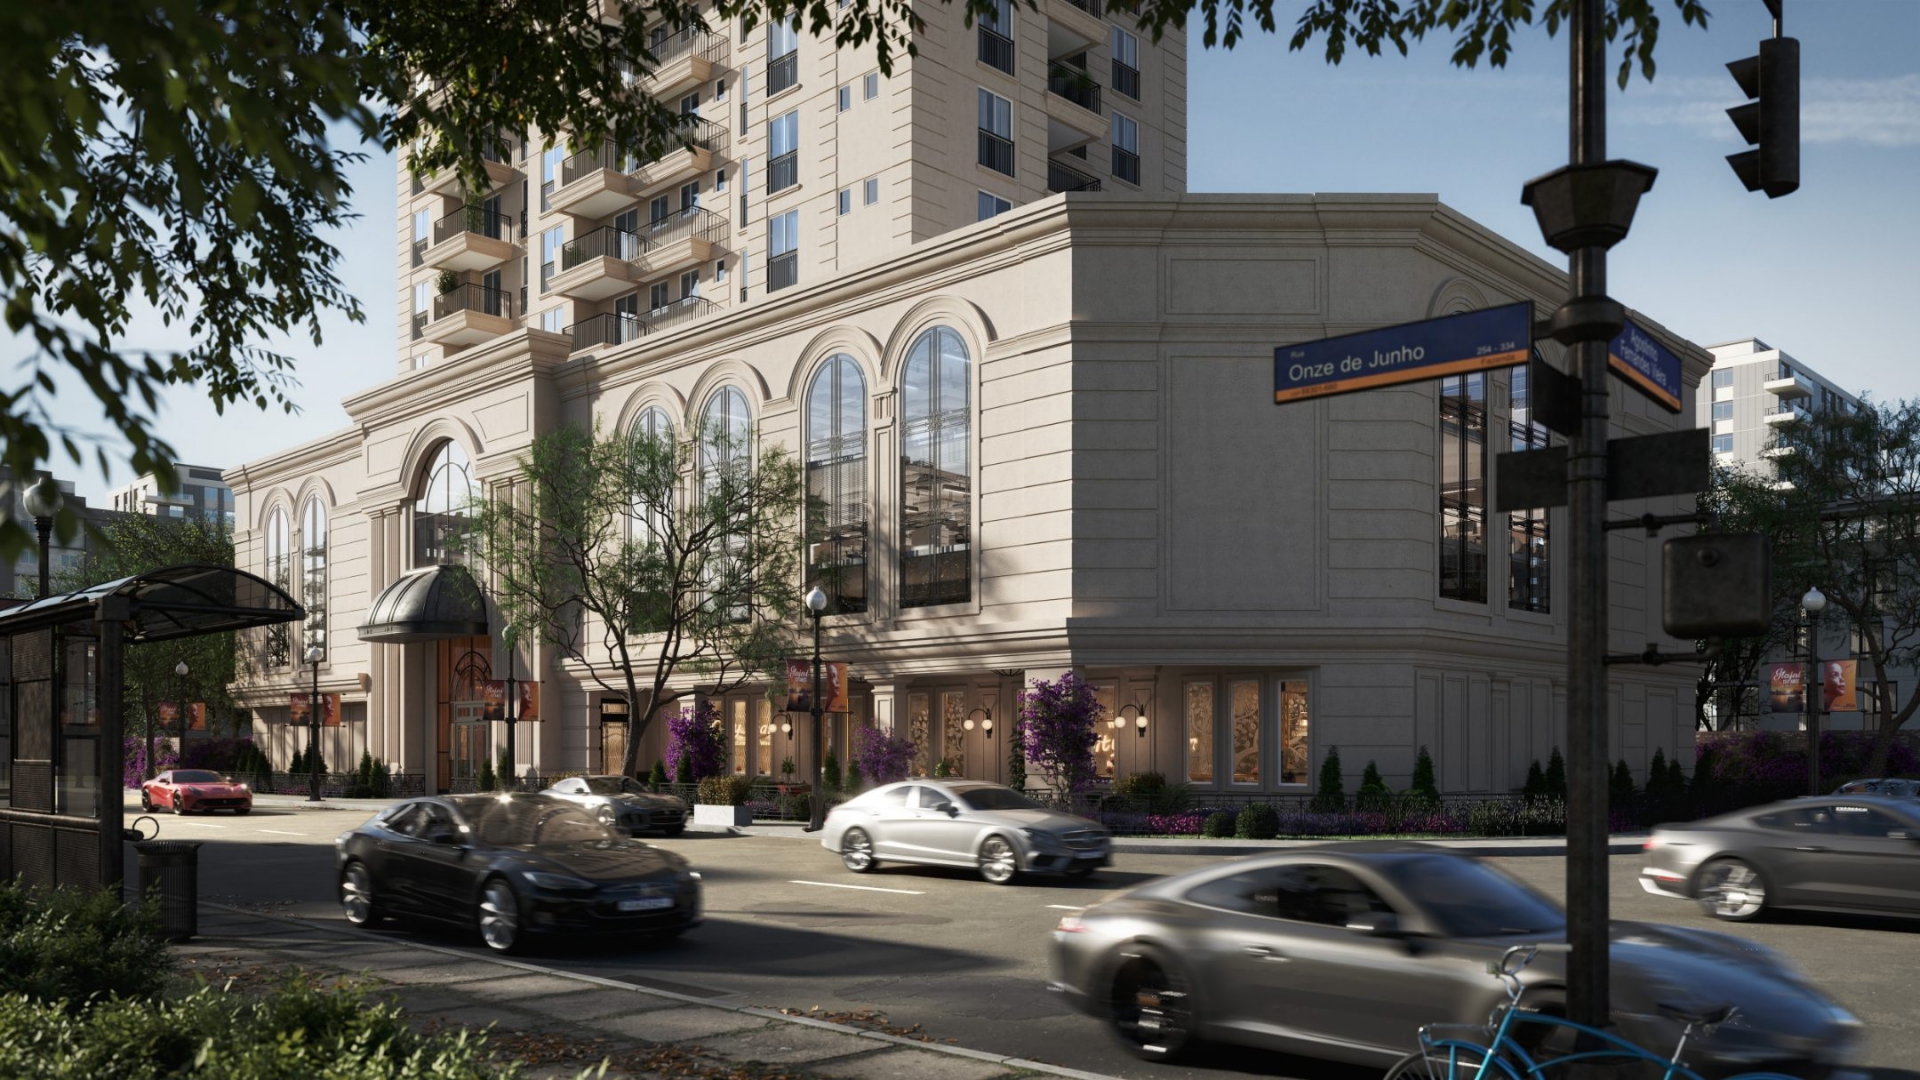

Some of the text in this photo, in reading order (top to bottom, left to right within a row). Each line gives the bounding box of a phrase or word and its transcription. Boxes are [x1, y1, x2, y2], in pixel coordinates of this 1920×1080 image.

[1289, 346, 1425, 381] Onze de Junho
